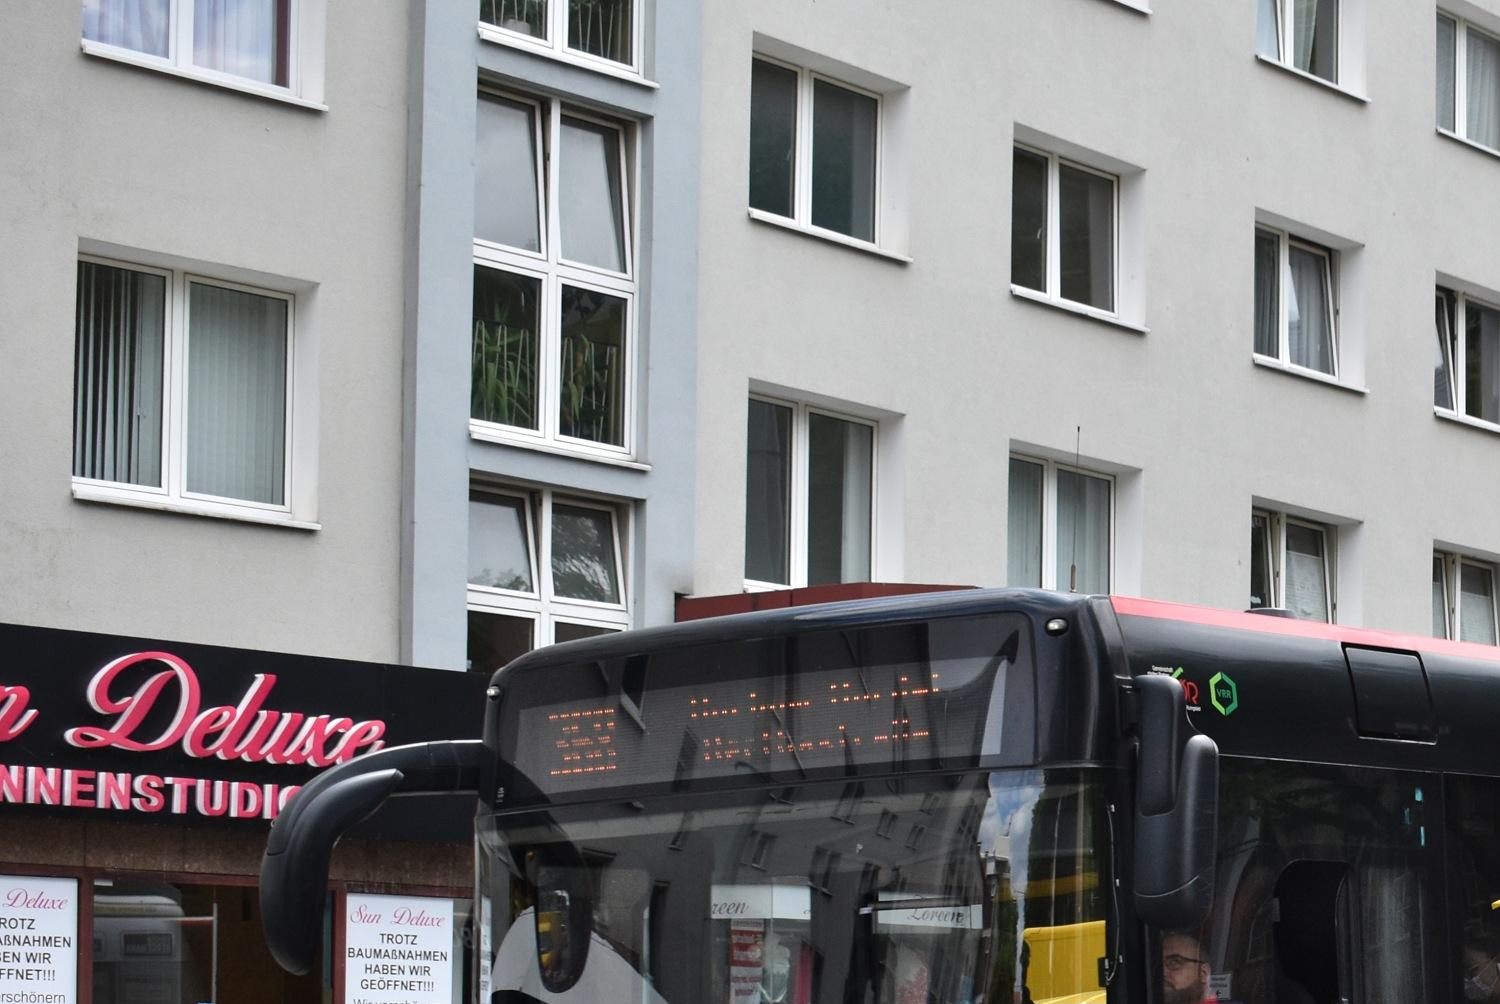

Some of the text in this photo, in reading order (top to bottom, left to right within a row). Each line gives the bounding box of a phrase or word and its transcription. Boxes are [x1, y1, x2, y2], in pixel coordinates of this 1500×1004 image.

[1216, 688, 1232, 699] VRR
[64, 651, 387, 768] Deluxe
[3, 888, 68, 911] Deluxe
[350, 904, 445, 928] Sun Deluxe
[380, 933, 418, 945] TROTZ
[26, 952, 52, 964] WIR
[348, 947, 448, 962] BAUMAßNAHMEN
[364, 964, 431, 977] HABEN WIR
[360, 977, 434, 993] GEÖFFNET!!!
[0, 991, 66, 1004] rschönern
